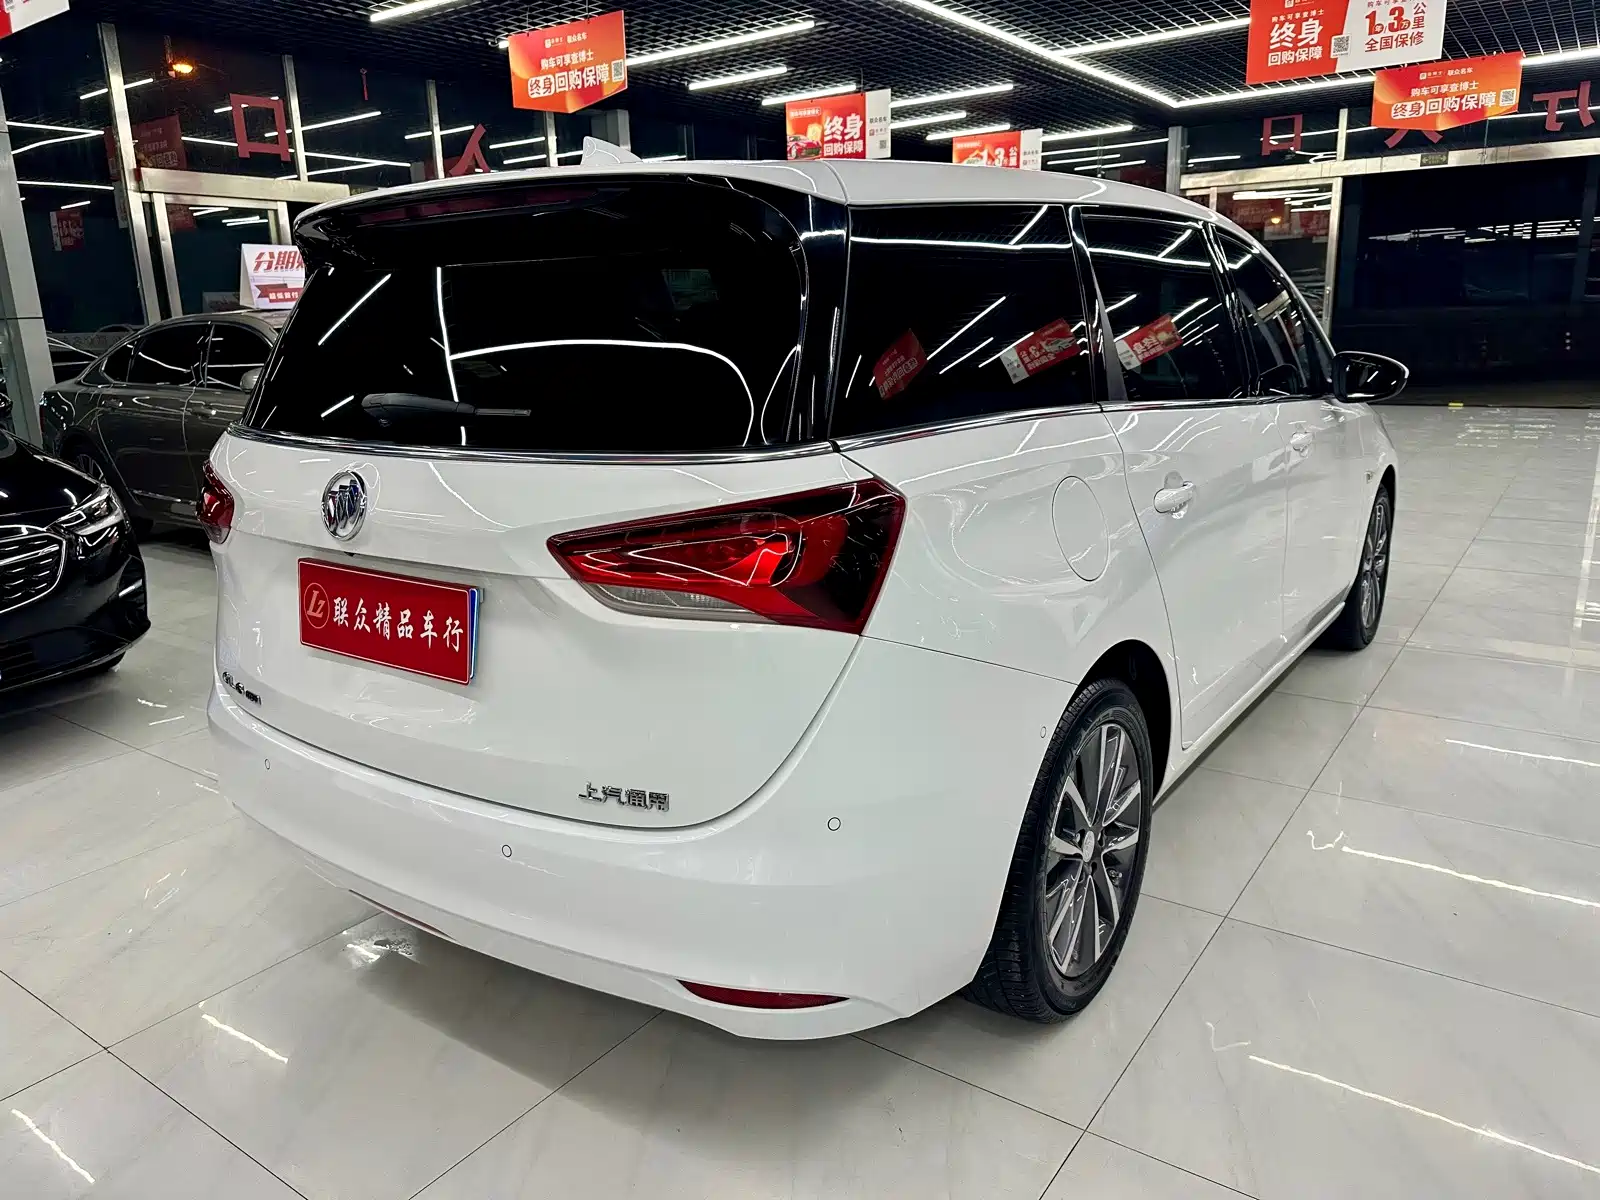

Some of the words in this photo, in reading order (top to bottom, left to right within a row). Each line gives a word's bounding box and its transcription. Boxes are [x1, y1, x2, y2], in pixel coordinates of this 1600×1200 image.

[1270, 18, 1323, 49] 终身
[1364, 31, 1425, 53] 全国保修
[540, 48, 594, 71] 购车可享查博士
[1267, 46, 1323, 67] 回购保障
[1410, 80, 1480, 98] 购车可享查博士
[1391, 91, 1497, 119] 终身回购保障
[823, 113, 863, 141] 终身
[823, 140, 864, 156] 回购保障
[333, 596, 464, 652] 联众精品车行
[578, 782, 670, 812] 上汽通用
